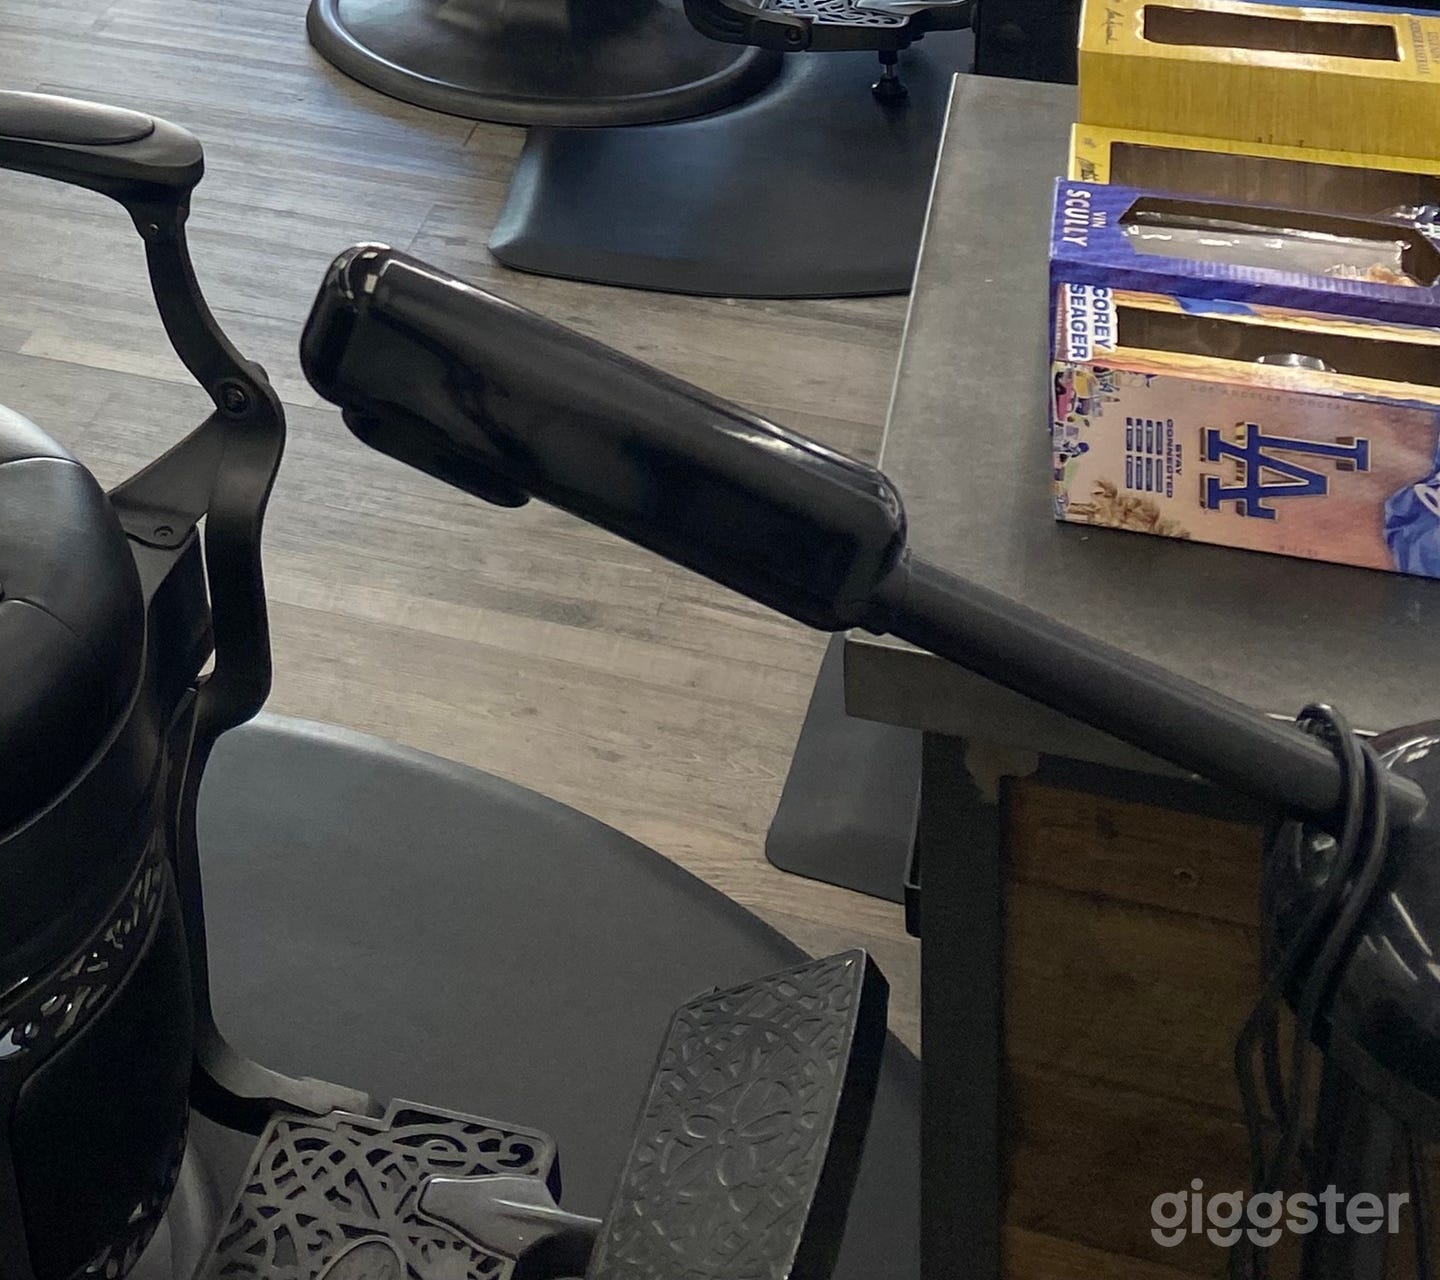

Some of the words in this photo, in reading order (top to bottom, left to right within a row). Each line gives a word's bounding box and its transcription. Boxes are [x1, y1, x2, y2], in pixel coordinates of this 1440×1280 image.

[1063, 189, 1091, 247] SCULLY
[1092, 212, 1107, 228] VIN
[1070, 284, 1088, 359] SEAGER
[1093, 286, 1111, 349] COREY
[1206, 422, 1372, 520] LA
